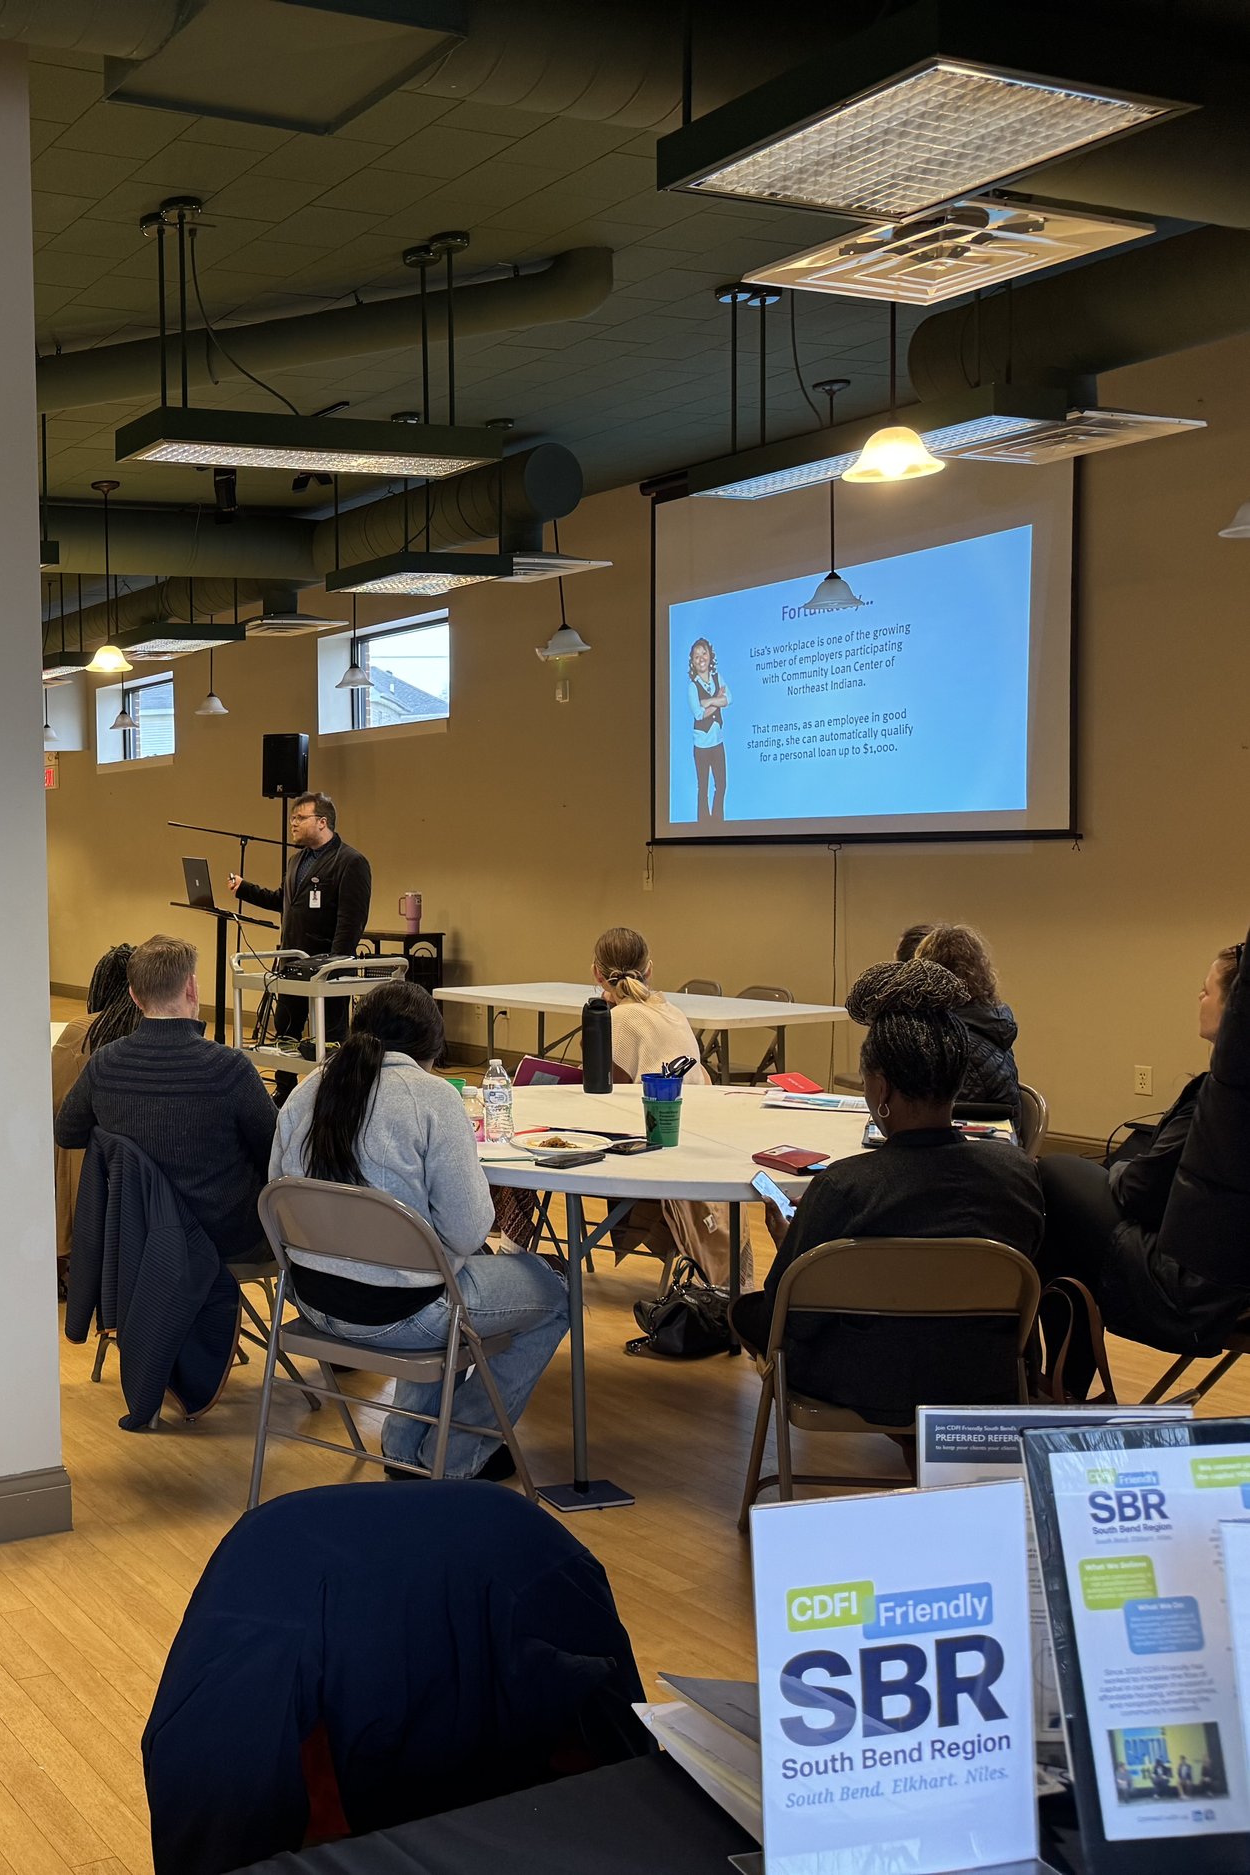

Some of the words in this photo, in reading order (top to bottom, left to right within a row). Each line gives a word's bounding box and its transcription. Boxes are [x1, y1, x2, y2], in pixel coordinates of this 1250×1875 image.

[750, 645, 771, 657] Lisa's
[773, 640, 815, 654] workplace
[817, 637, 824, 646] is
[827, 636, 842, 645] one
[845, 631, 855, 642] of
[856, 630, 870, 640] the
[873, 623, 911, 639] growing
[756, 658, 786, 671] number
[789, 655, 797, 666] of
[799, 649, 846, 664] employers
[845, 640, 903, 659] participating
[762, 673, 779, 684] with
[782, 666, 828, 682] Community
[831, 664, 851, 675] Loan
[854, 660, 882, 672] Center
[885, 656, 895, 667] of
[787, 682, 828, 695] Northeast
[831, 677, 866, 689] Indiana.
[752, 724, 770, 734] That
[772, 722, 800, 733] means,
[803, 721, 812, 729] as
[815, 719, 825, 728] an
[827, 715, 869, 727] employee
[872, 712, 879, 722] in
[883, 708, 907, 723] good
[747, 737, 784, 749] standing,
[786, 735, 800, 745] she
[802, 735, 817, 744] can
[819, 728, 878, 742] automatically
[881, 724, 913, 738] qualify
[760, 752, 771, 762] for
[773, 752, 778, 761] a
[780, 748, 816, 762] personal
[818, 746, 837, 757] loan
[838, 746, 849, 757] up
[852, 746, 861, 754] to
[863, 743, 897, 755] $1,000.
[936, 1434, 985, 1442] PREFERRED
[1089, 1488, 1169, 1523] SBR
[1093, 1527, 1118, 1535] South
[1143, 1524, 1172, 1532] Region
[791, 1591, 858, 1621] CDFI
[878, 1592, 988, 1627] Friendly
[779, 1634, 1008, 1747] SBR
[781, 1752, 854, 1780] South
[862, 1742, 922, 1770] Bend
[930, 1734, 1011, 1761] Region
[785, 1789, 834, 1809] South
[839, 1781, 884, 1801] Bend.
[892, 1773, 957, 1795] Elkhart.
[965, 1766, 1008, 1785] Niles.
